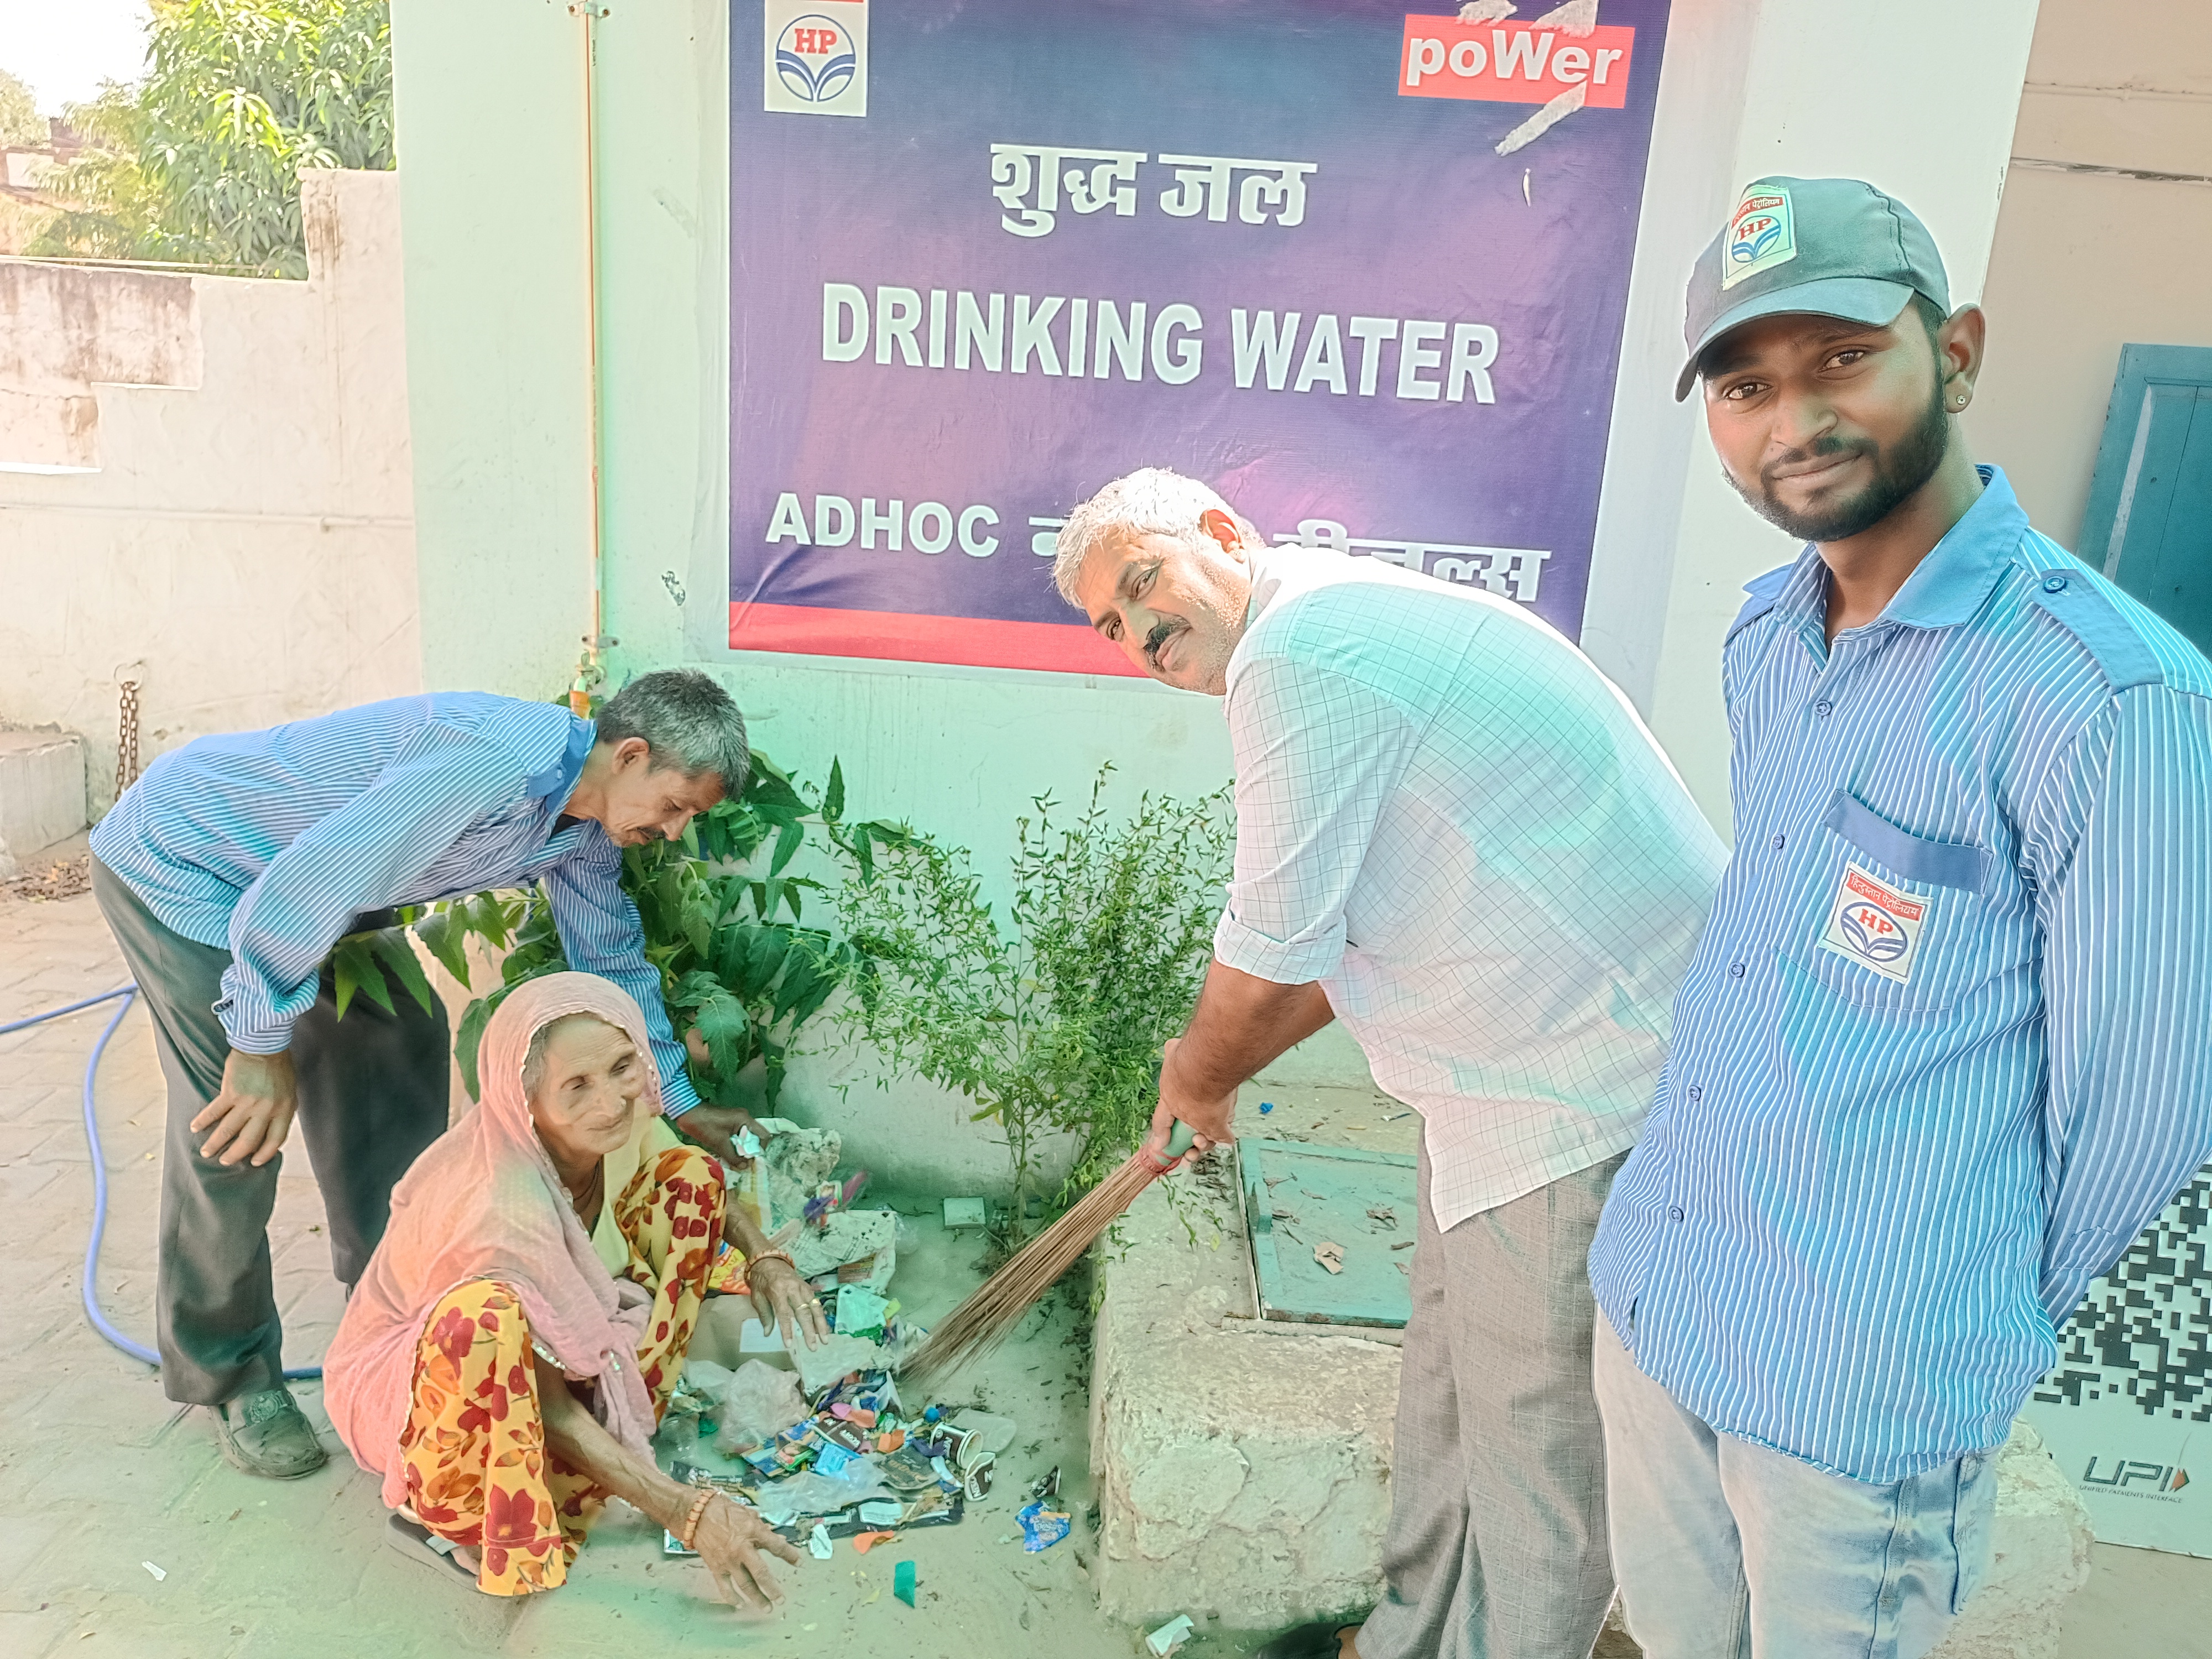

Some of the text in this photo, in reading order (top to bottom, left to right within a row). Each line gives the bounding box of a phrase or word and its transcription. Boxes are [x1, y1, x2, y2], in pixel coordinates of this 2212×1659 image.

[795, 28, 837, 54] HP
[1406, 29, 1623, 86] poWer
[990, 144, 1318, 237] शुद्ध जल
[1739, 218, 1772, 241] HP
[822, 283, 1499, 404] DRINKING WATER
[765, 492, 999, 558] ADHOC
[1858, 909, 1893, 935] HP
[2084, 1456, 2173, 1492] UPI
